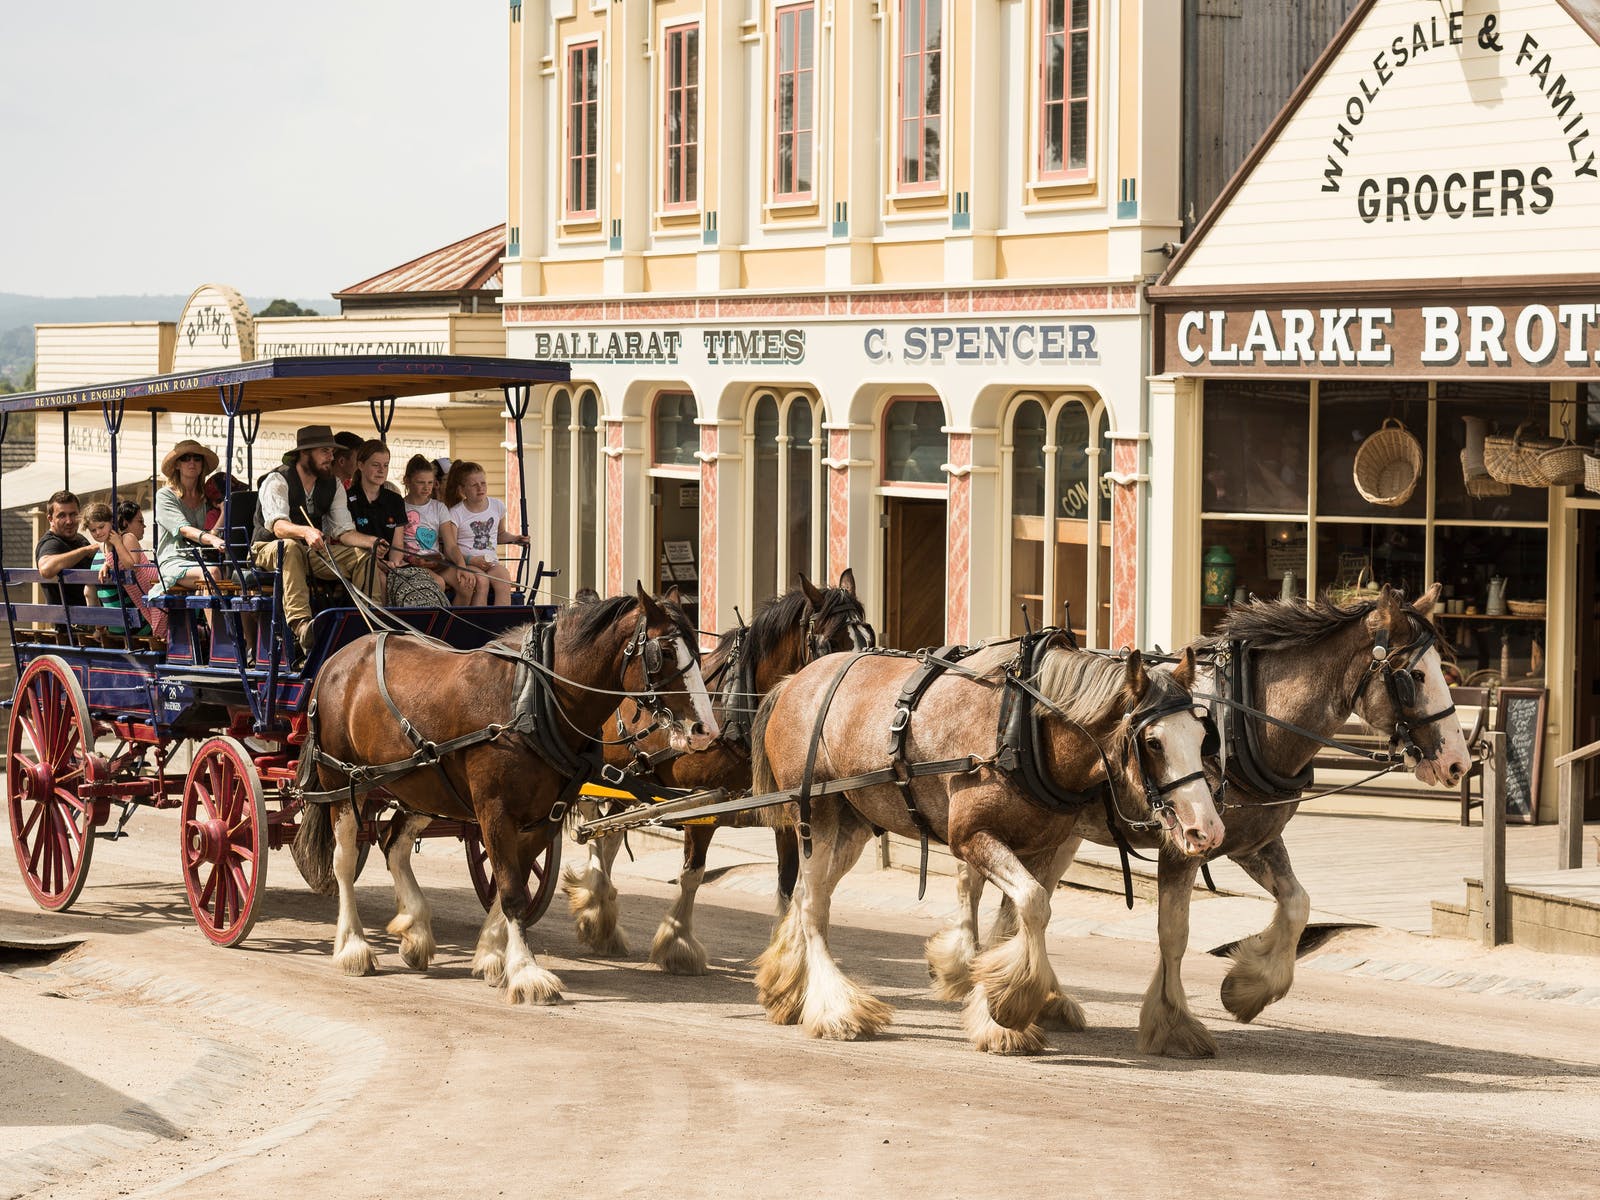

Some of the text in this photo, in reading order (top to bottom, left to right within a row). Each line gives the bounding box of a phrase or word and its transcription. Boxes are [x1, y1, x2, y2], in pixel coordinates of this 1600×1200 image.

[1321, 11, 1598, 193] WHOLESALE & FAMILY
[1357, 166, 1554, 224] GROCERS
[535, 329, 806, 365] BALLARAT TIMES
[864, 324, 1101, 362] C. SPENCER
[1177, 303, 1600, 368] CLARKE BROT
[35, 388, 127, 407] REYNOLDS & ENGLISH
[148, 377, 199, 394] MAIN ROAD
[69, 426, 94, 452] ALEX
[184, 415, 227, 439] HOTEL
